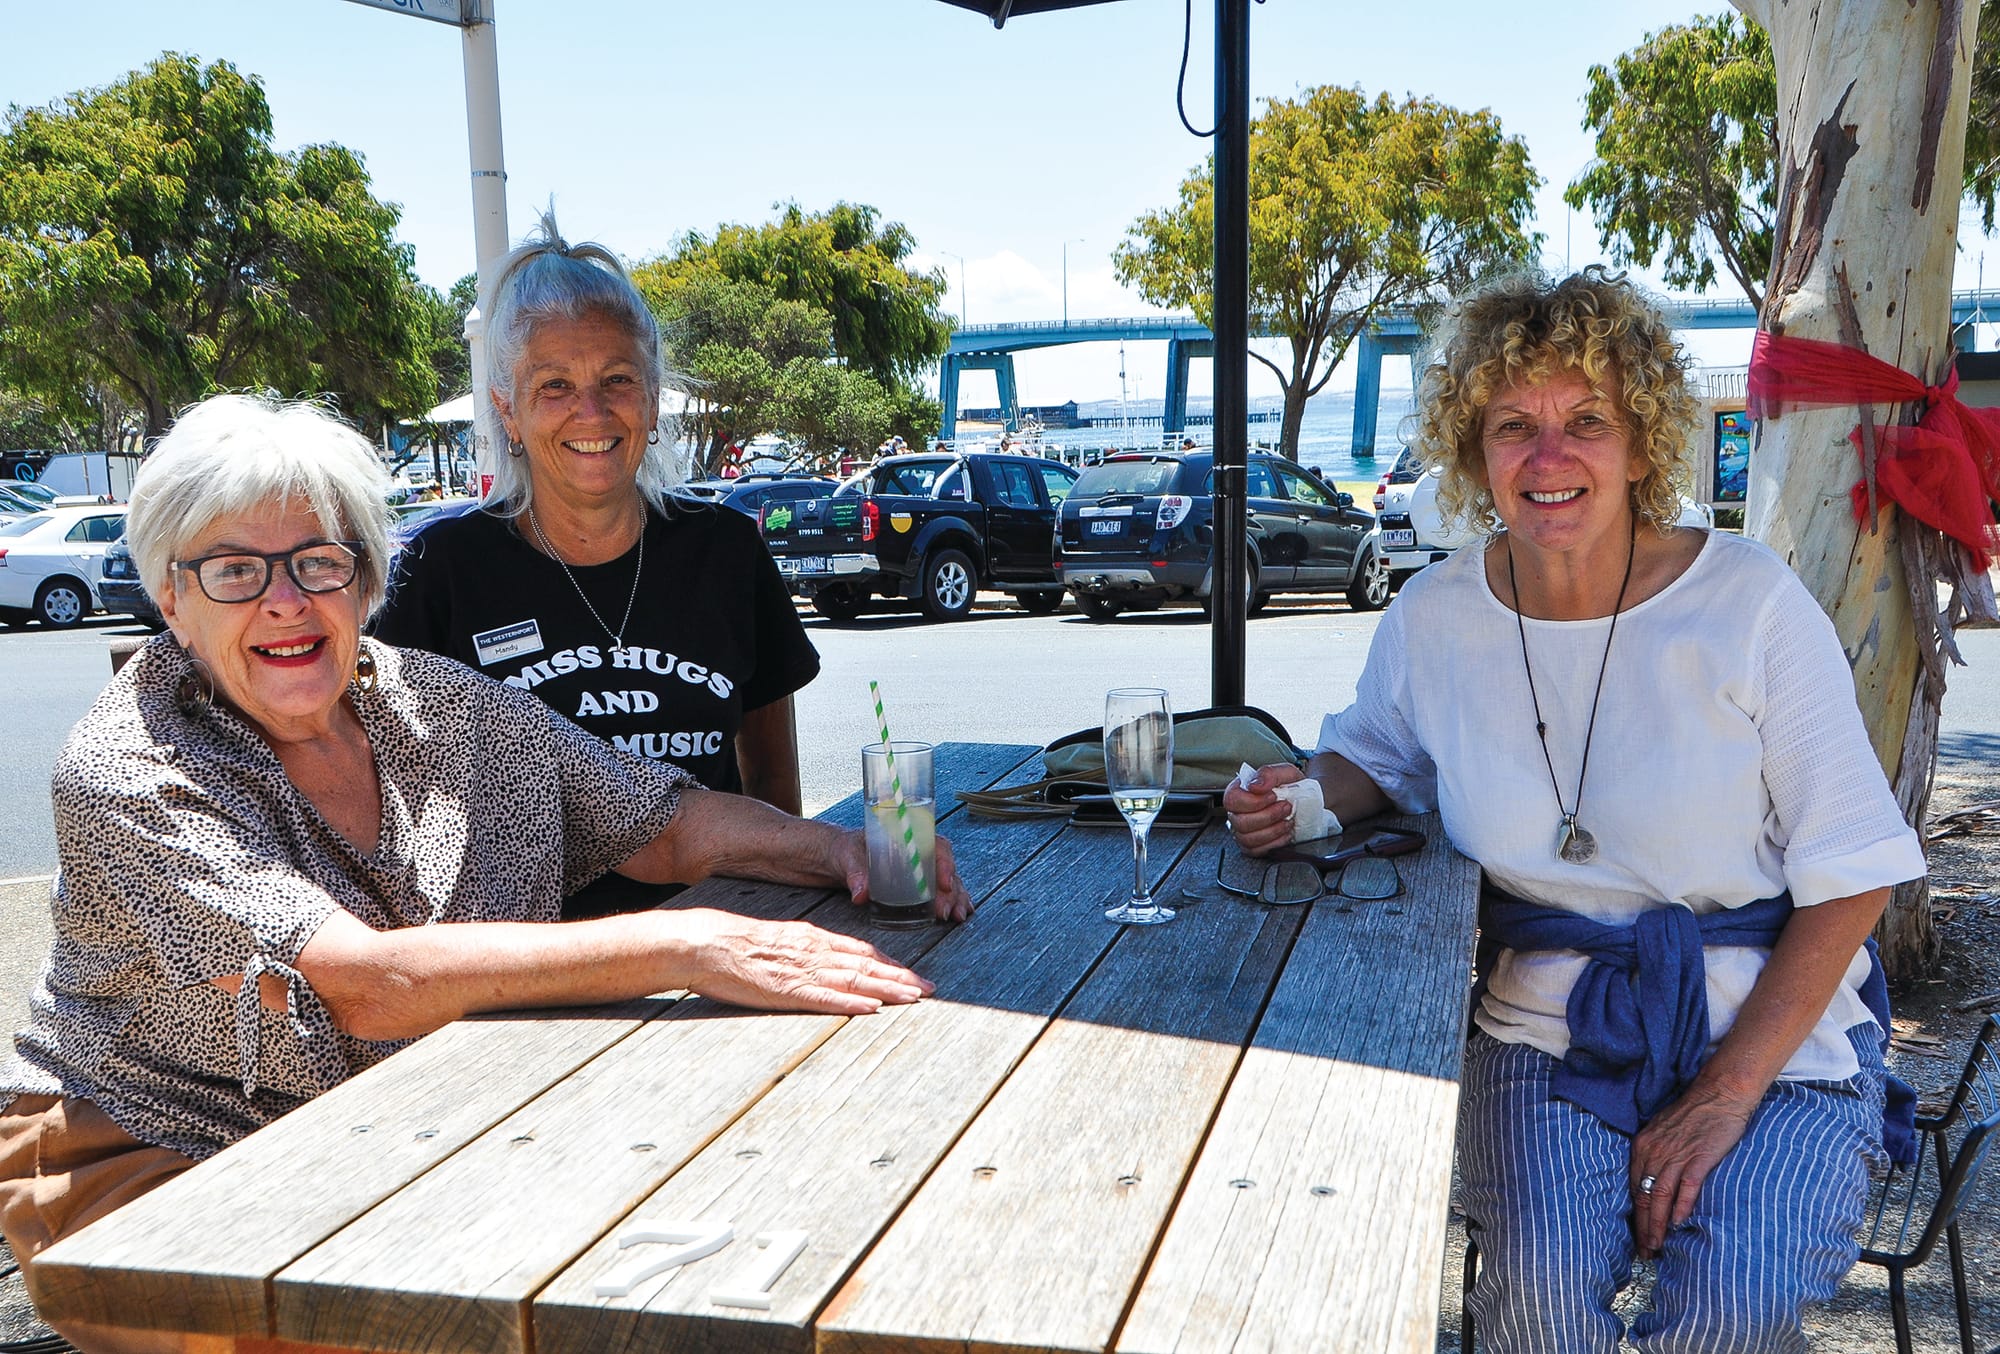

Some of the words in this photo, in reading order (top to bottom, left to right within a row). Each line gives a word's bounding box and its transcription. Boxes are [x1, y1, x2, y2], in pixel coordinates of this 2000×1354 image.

[480, 638, 493, 646] THE
[493, 625, 535, 642] WESTERNPORT
[495, 643, 519, 655] Mandy
[503, 645, 603, 691] MISS
[608, 645, 734, 699] HUGS
[575, 690, 660, 717] AND
[611, 730, 723, 759] MUSIC
[594, 1218, 810, 1311] 71
